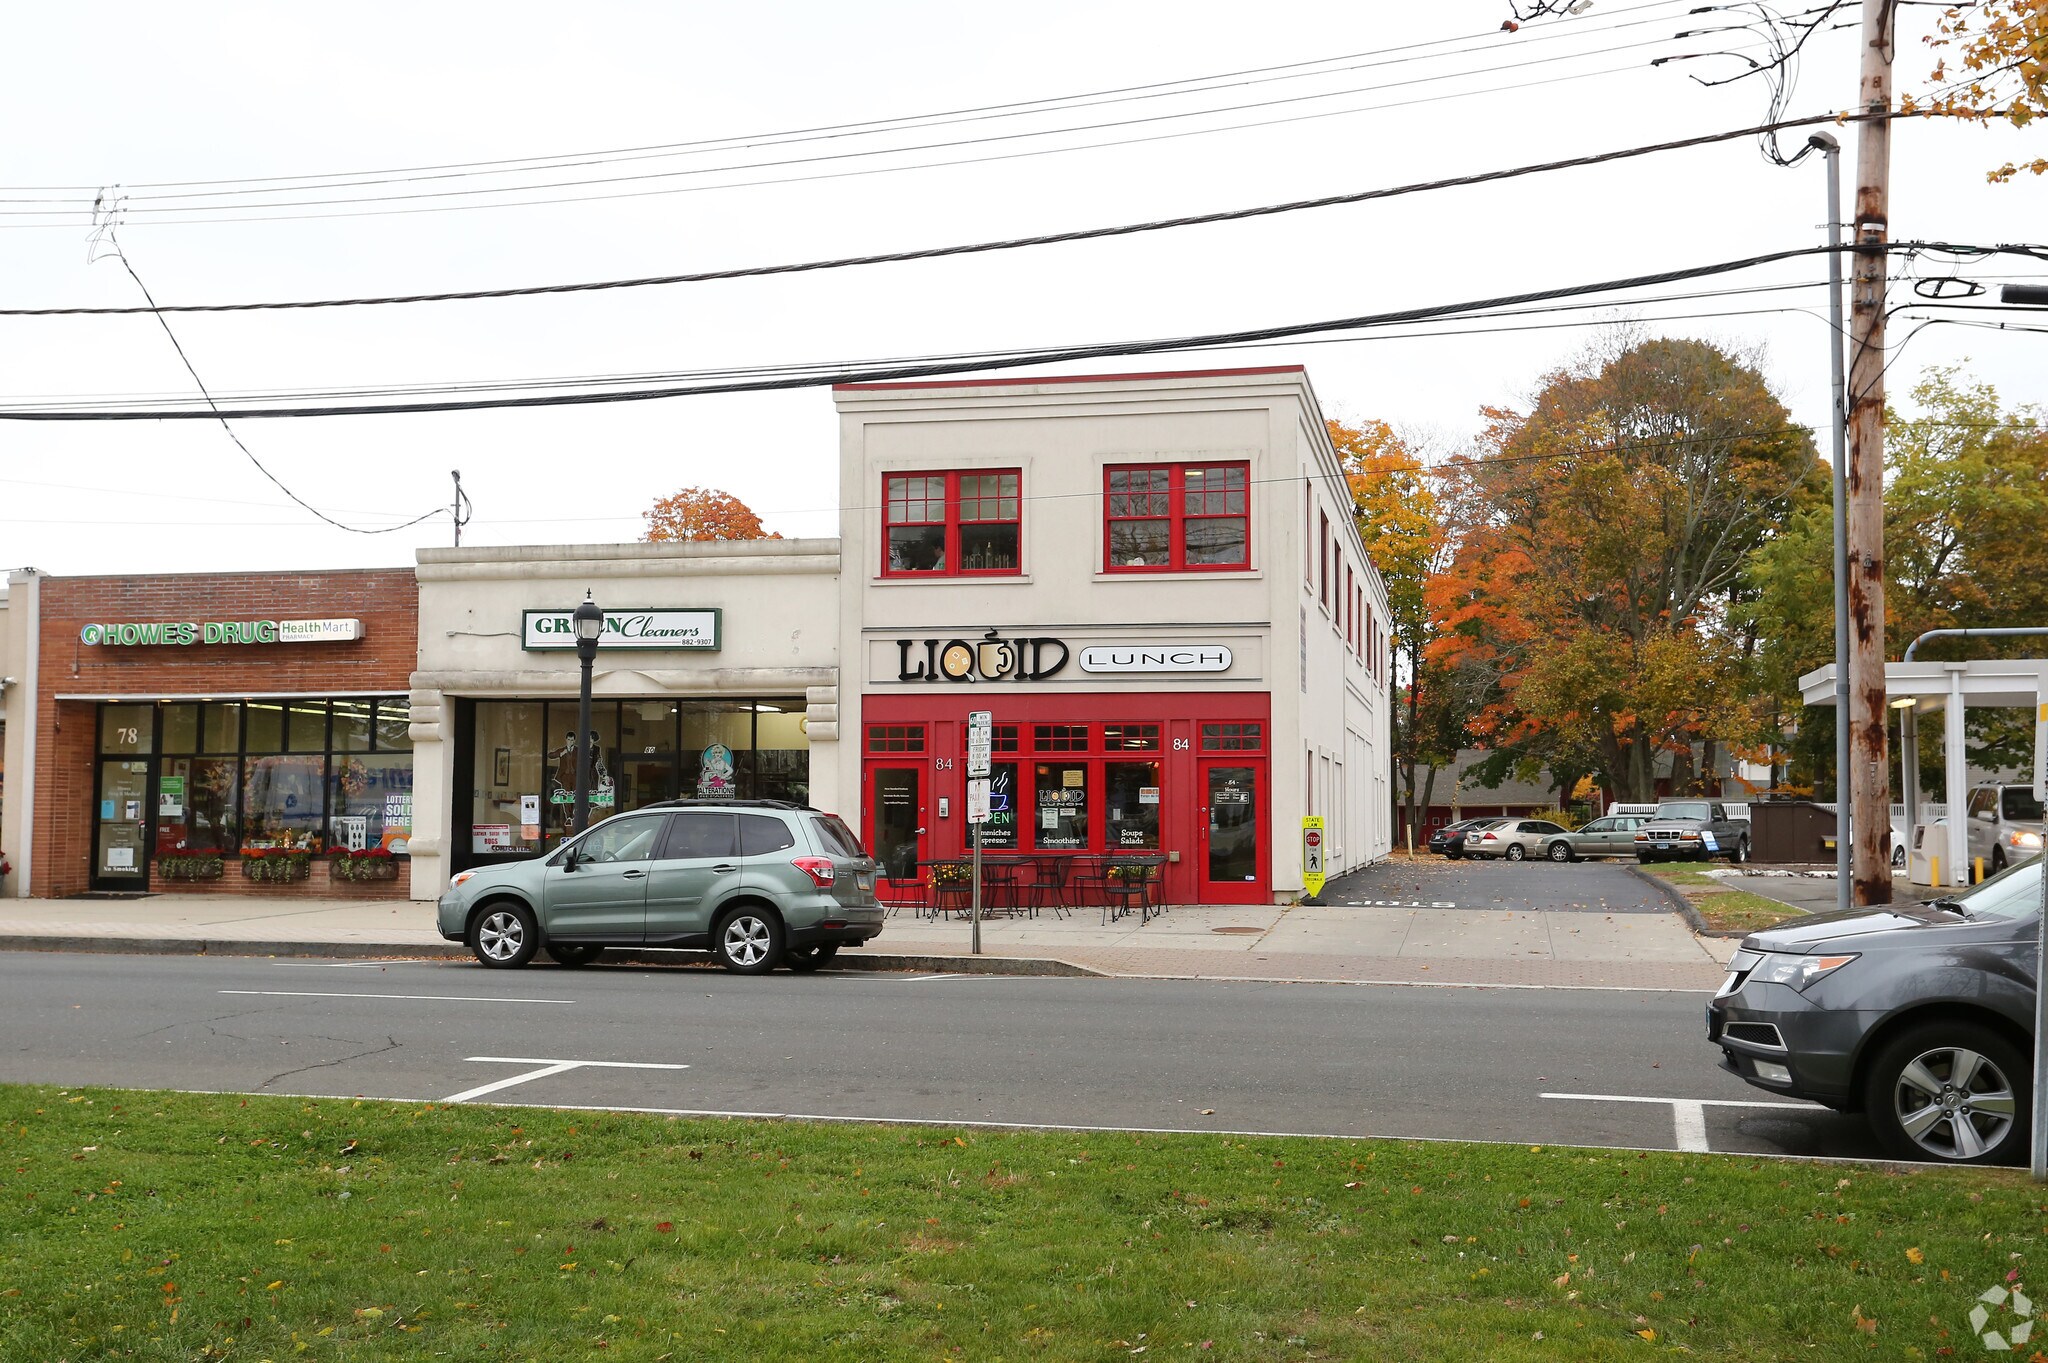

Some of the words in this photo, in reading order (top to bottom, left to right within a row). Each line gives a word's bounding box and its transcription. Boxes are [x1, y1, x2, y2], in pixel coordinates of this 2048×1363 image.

[282, 622, 321, 634] Health
[535, 617, 622, 634] GRN
[620, 615, 700, 638] Cleaners
[103, 623, 195, 646] HOWES
[203, 620, 275, 644] DRUG
[897, 634, 1070, 684] LIQUID
[1088, 652, 1223, 666] LUNCH
[117, 727, 138, 744] 78
[1173, 738, 1190, 750] 84
[935, 757, 953, 770] 84
[987, 811, 1010, 825] PEN
[1121, 829, 1143, 838] Soups
[981, 837, 1007, 846] spresso
[1043, 836, 1080, 845] Smoothies
[1120, 837, 1144, 845] Salads
